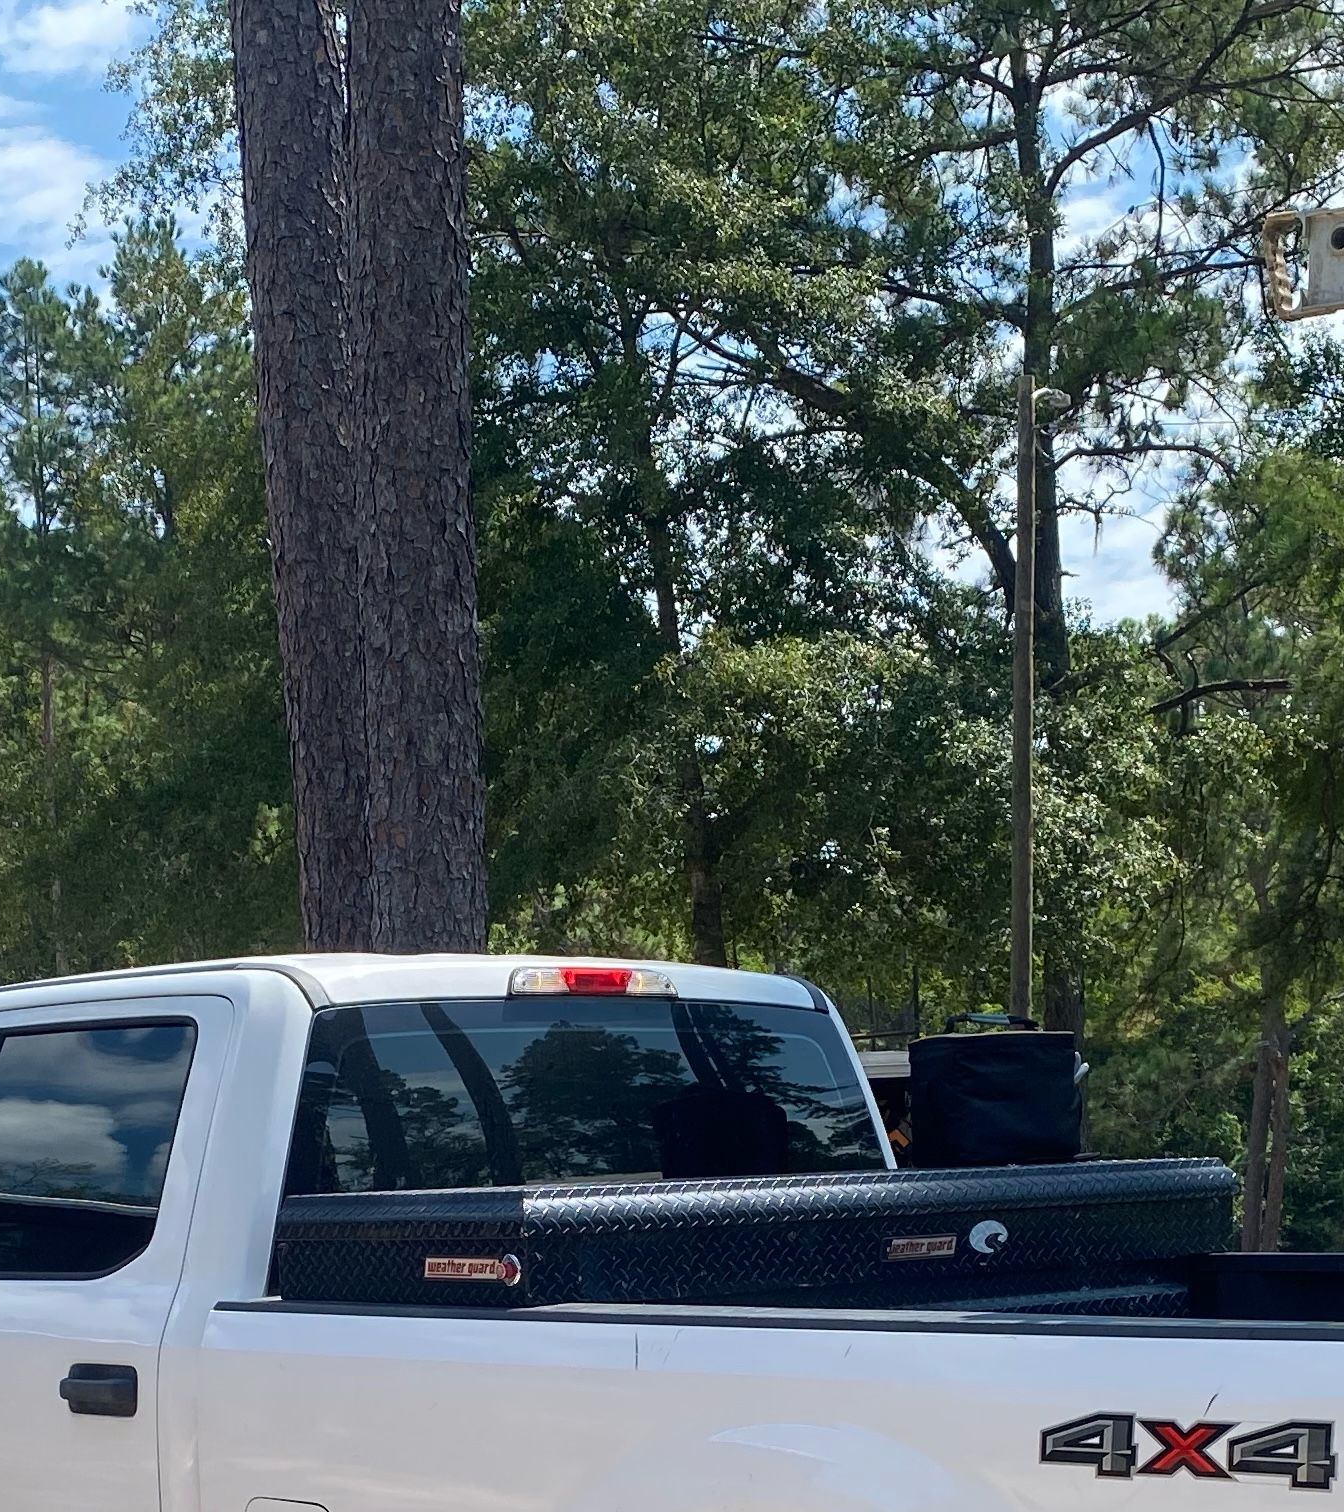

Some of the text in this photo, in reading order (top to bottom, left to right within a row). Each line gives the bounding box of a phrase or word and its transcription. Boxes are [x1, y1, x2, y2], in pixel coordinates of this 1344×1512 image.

[926, 1238, 954, 1253] guard
[427, 1260, 496, 1274] weather guard
[1039, 1411, 1337, 1492] 4X4
